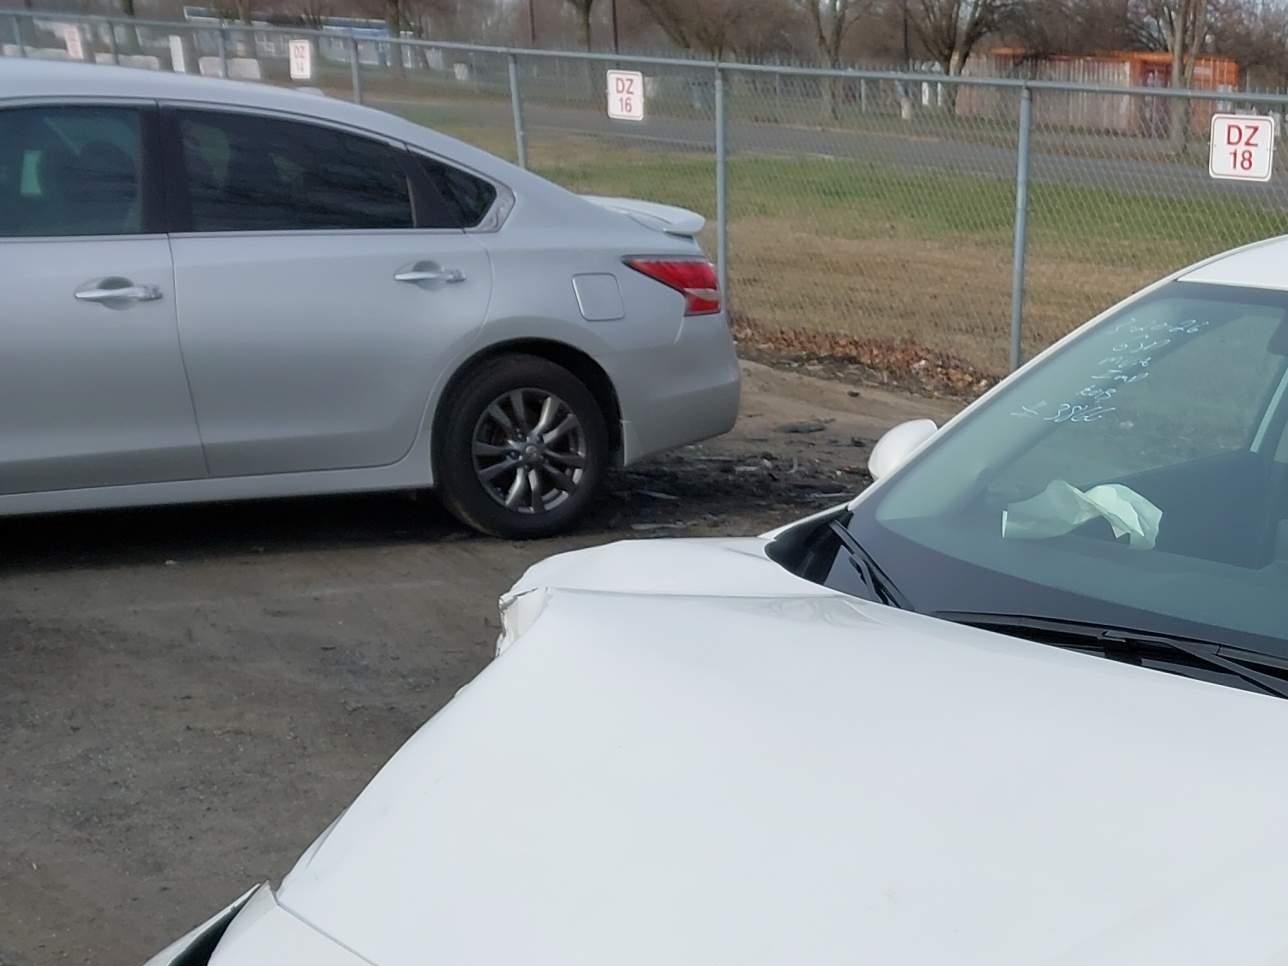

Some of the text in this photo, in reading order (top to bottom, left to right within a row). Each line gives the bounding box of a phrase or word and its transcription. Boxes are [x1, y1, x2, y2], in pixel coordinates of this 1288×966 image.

[616, 77, 634, 95] DZ
[620, 97, 632, 113] 16
[1227, 124, 1259, 147] DZ
[1230, 149, 1253, 170] 18
